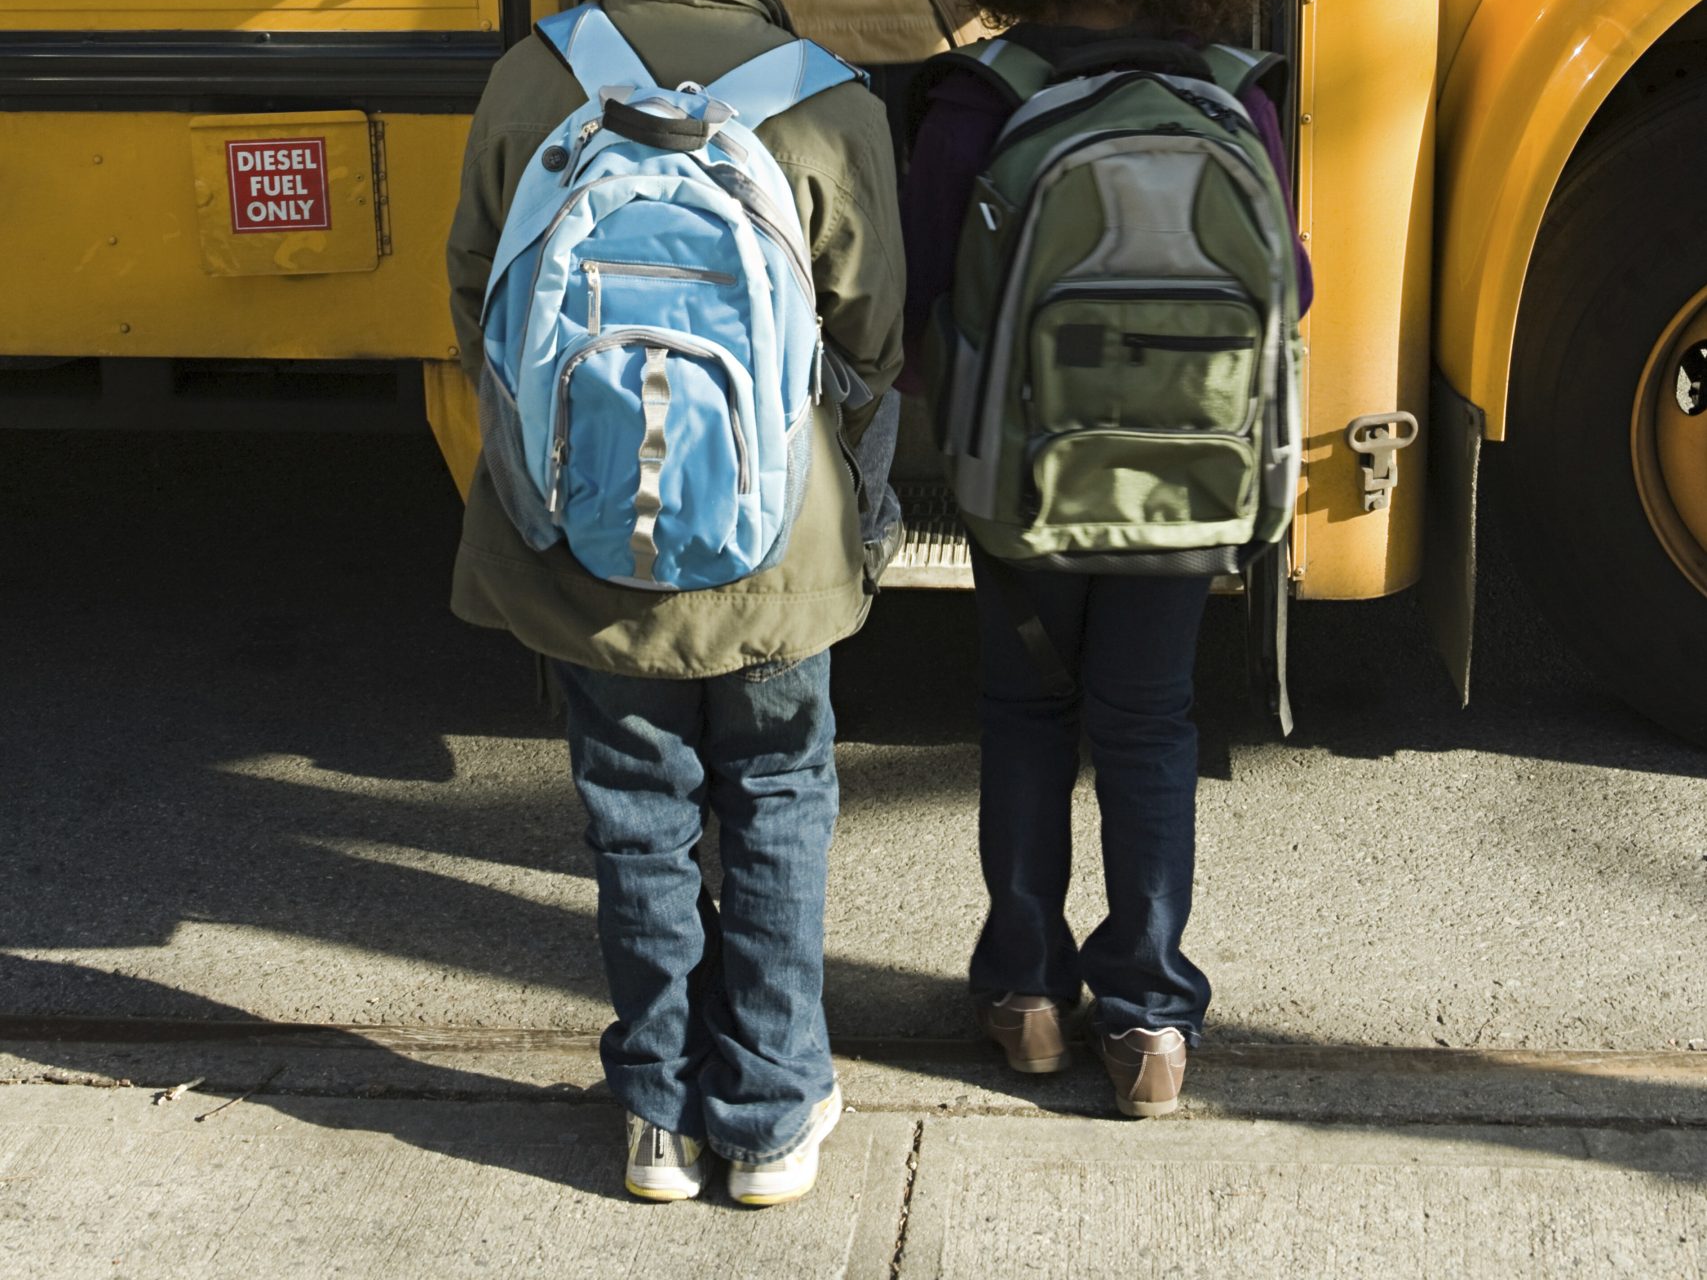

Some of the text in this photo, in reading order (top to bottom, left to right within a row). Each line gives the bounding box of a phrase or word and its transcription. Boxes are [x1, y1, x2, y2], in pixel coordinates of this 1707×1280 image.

[237, 149, 317, 172] DIESEL
[250, 175, 308, 197] FUEL
[246, 199, 314, 222] ONLY
